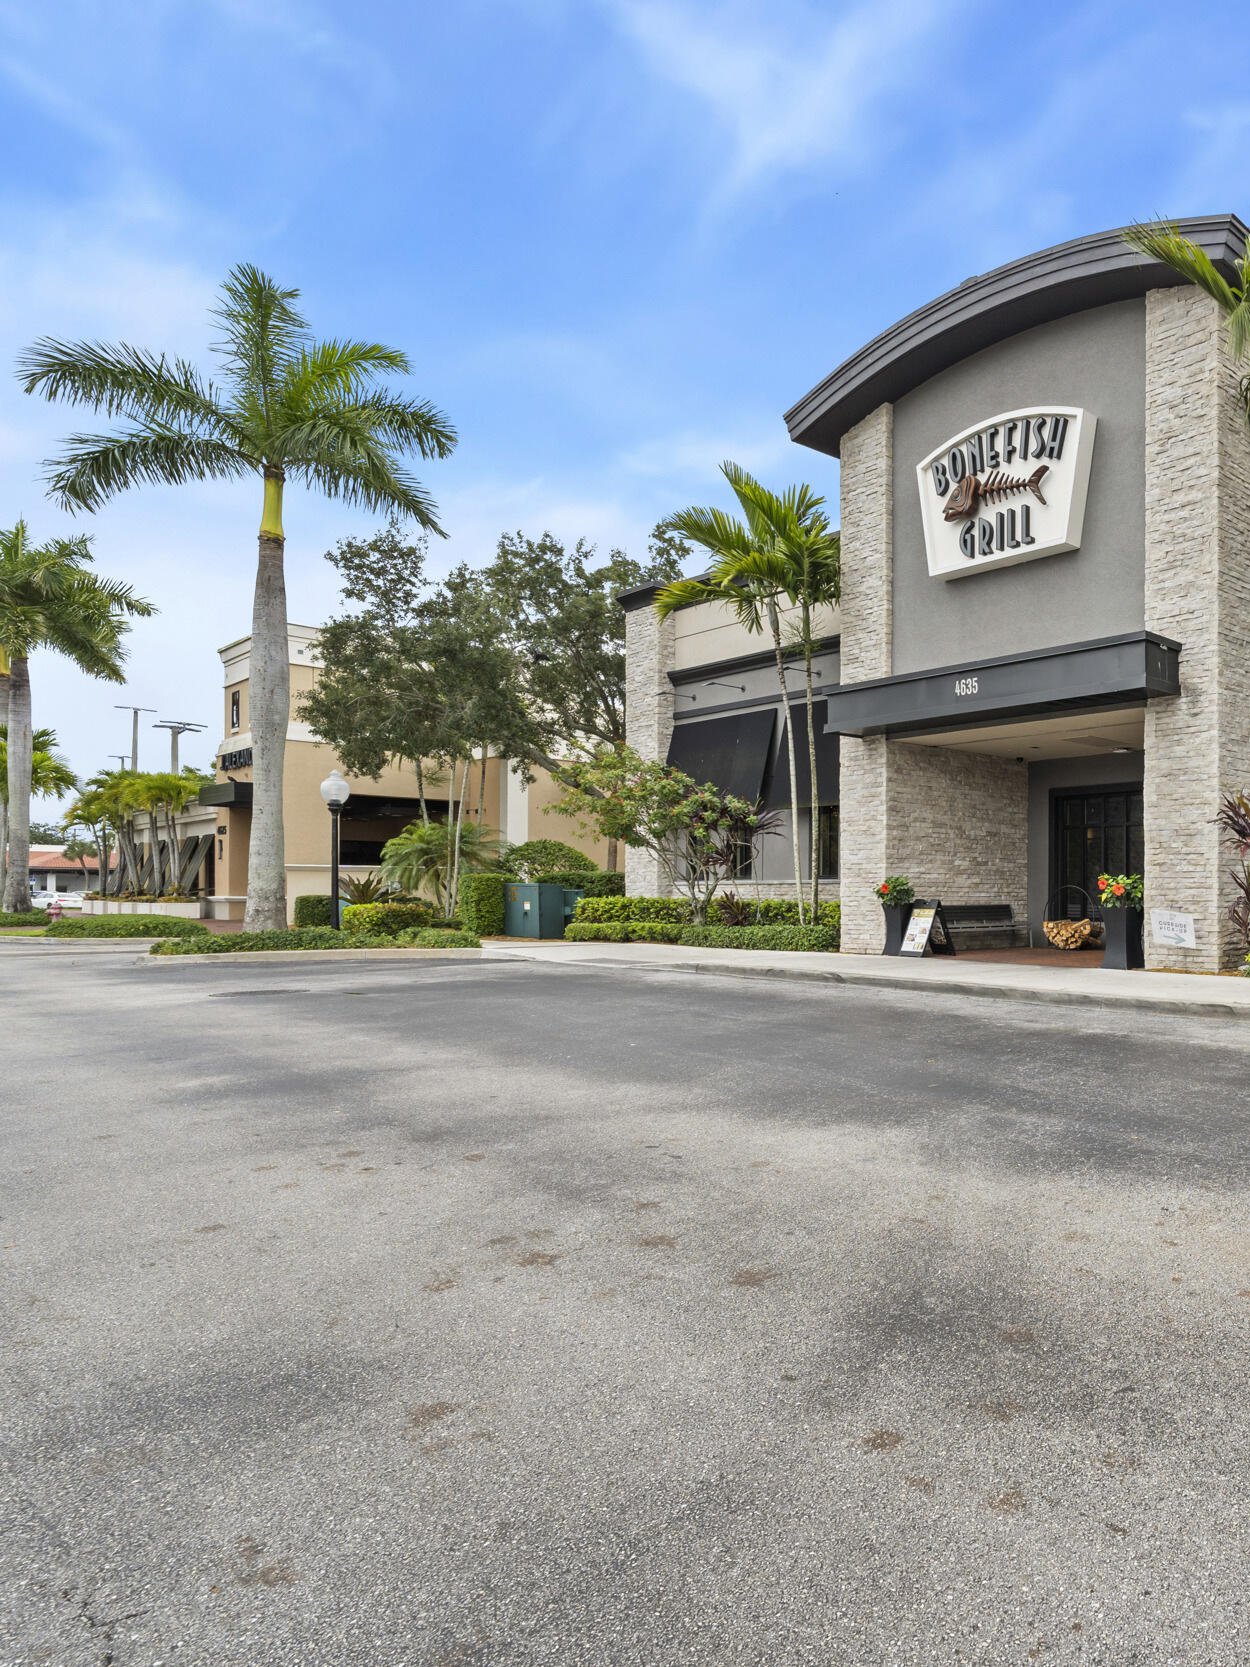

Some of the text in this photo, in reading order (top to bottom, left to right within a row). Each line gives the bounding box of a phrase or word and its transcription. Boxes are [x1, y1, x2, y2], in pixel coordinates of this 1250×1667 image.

[931, 416, 1069, 497] BONEFISH
[959, 504, 1036, 559] GRILL
[955, 677, 978, 696] 4635
